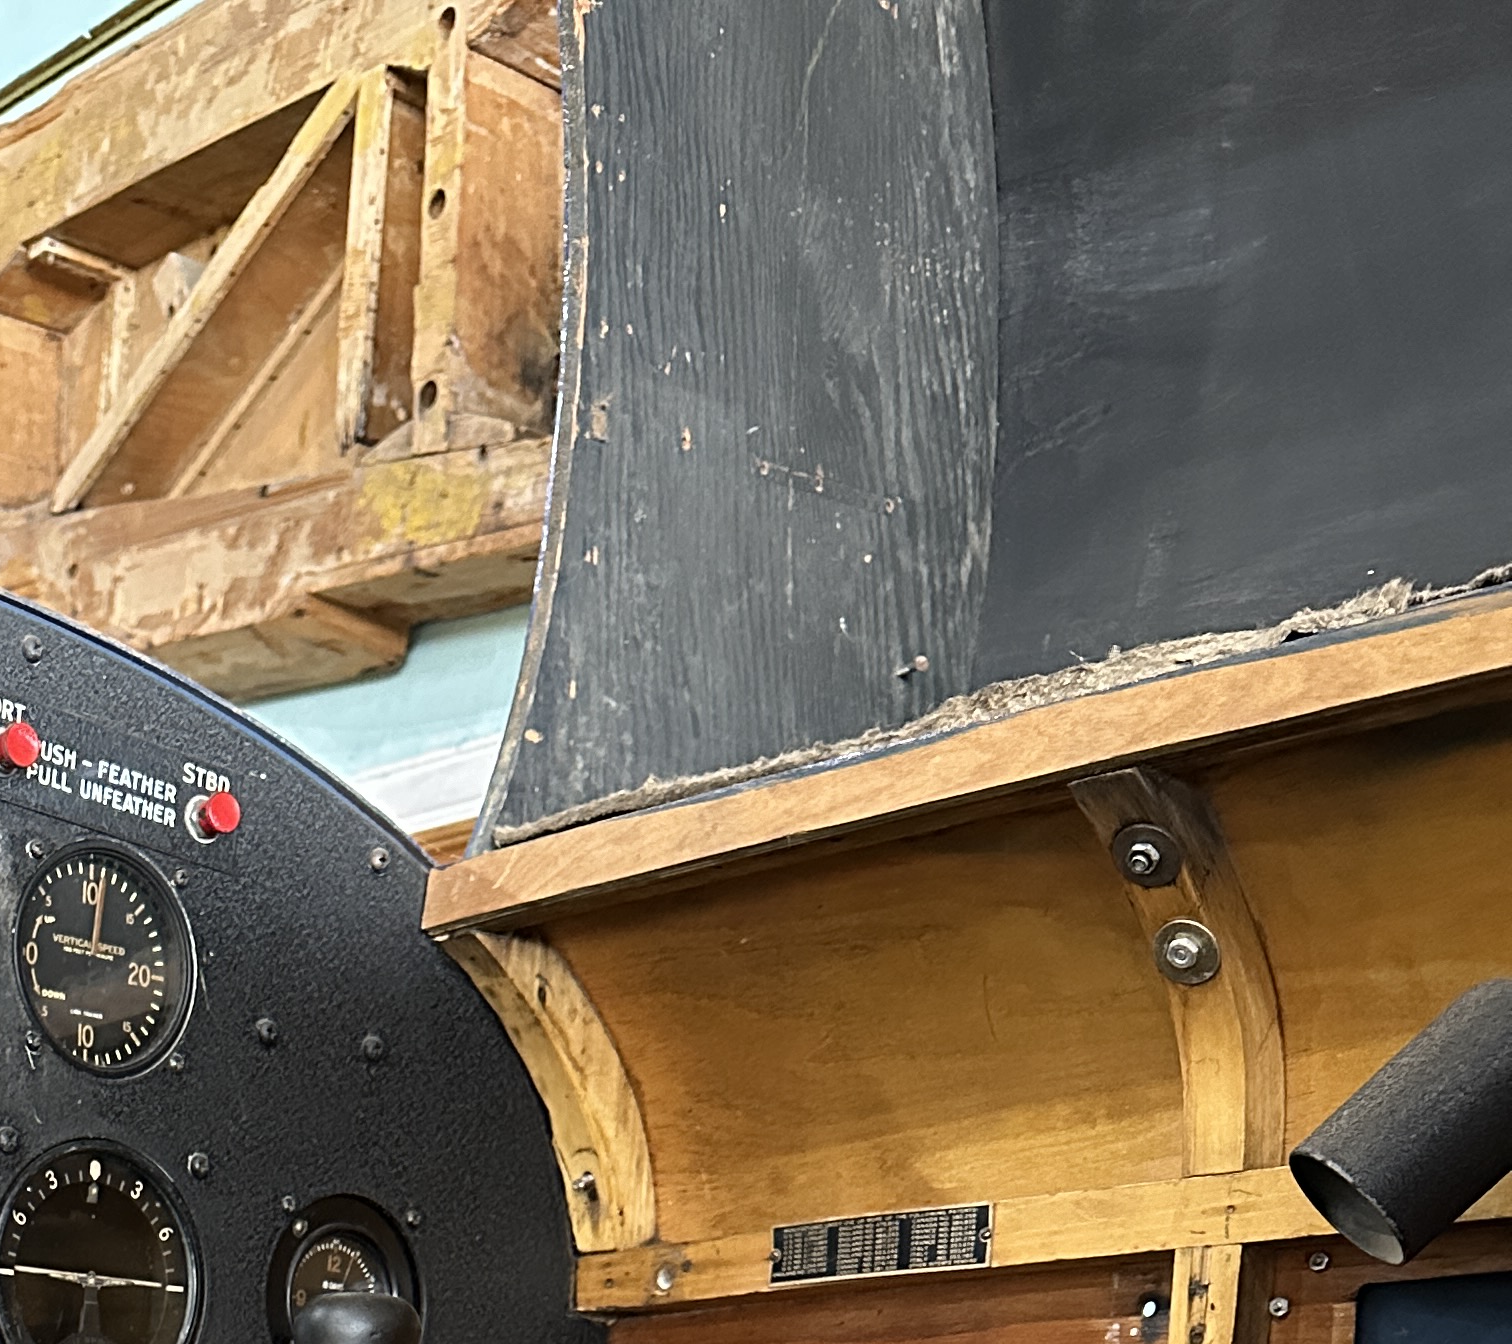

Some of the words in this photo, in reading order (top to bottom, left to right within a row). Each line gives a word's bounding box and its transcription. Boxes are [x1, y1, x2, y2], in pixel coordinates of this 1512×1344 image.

[40, 740, 77, 770] USH
[97, 759, 177, 804] FEATHER
[182, 762, 231, 793] STBD
[26, 762, 72, 794] PULL
[79, 778, 176, 828] UNFEATHER
[45, 896, 51, 907] 5
[82, 880, 99, 906] 10
[126, 913, 135, 925] 15
[26, 941, 38, 965] 0
[98, 941, 126, 956] SPEED
[128, 962, 151, 988] 20
[41, 988, 66, 1001] DOWN
[40, 1005, 48, 1017] 5
[77, 1023, 94, 1048] 10
[122, 1021, 132, 1033] 15
[44, 1169, 59, 1190] 3
[130, 1180, 144, 1200] 3
[12, 1209, 27, 1226] 6
[158, 1226, 174, 1242] 6
[327, 1254, 341, 1273] 12
